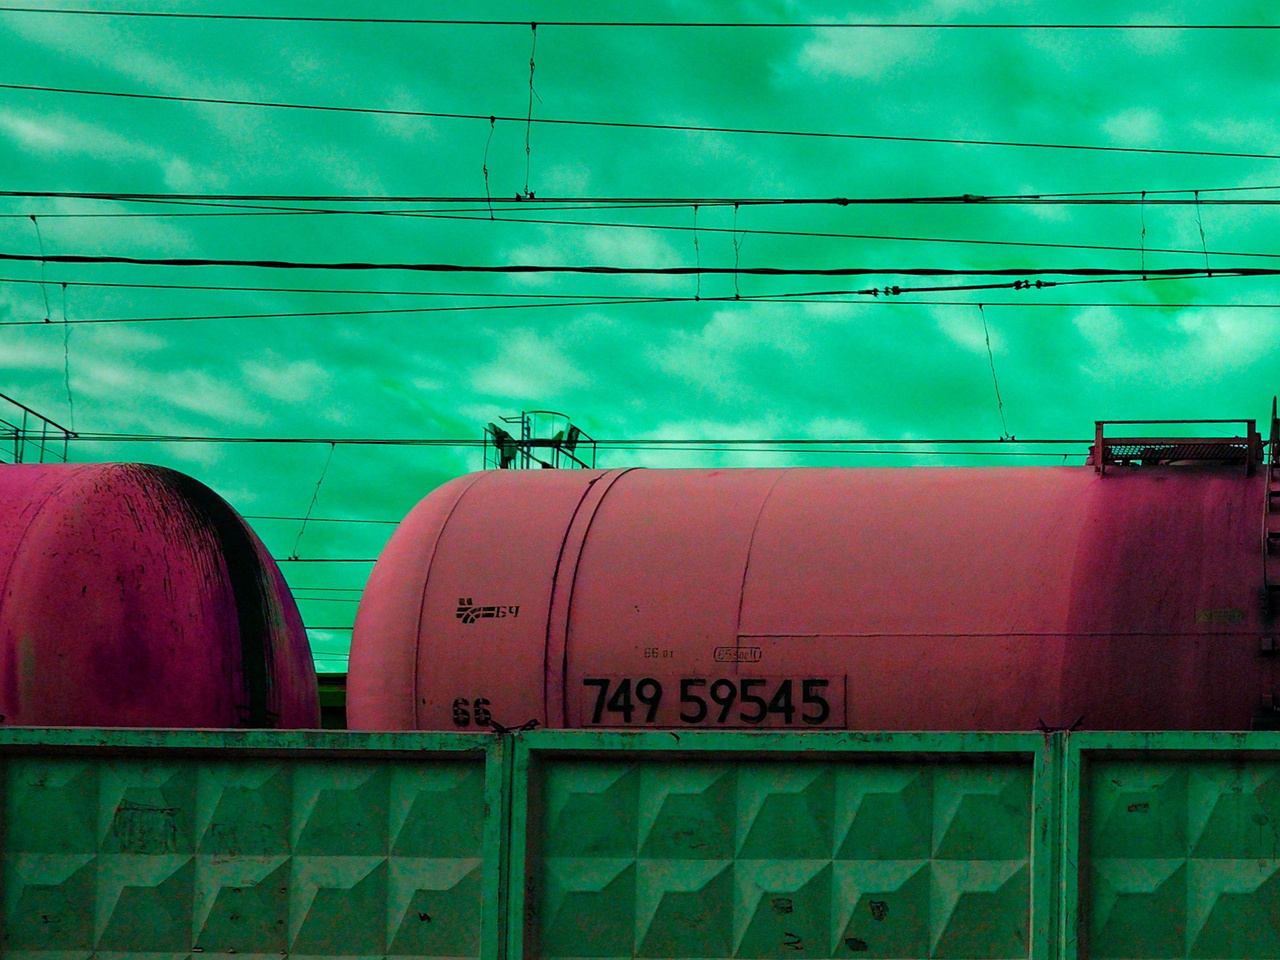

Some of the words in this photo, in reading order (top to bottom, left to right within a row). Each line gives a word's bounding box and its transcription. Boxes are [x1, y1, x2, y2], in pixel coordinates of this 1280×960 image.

[453, 697, 492, 727] 66
[583, 678, 663, 724] 749
[680, 678, 830, 725] 59545
